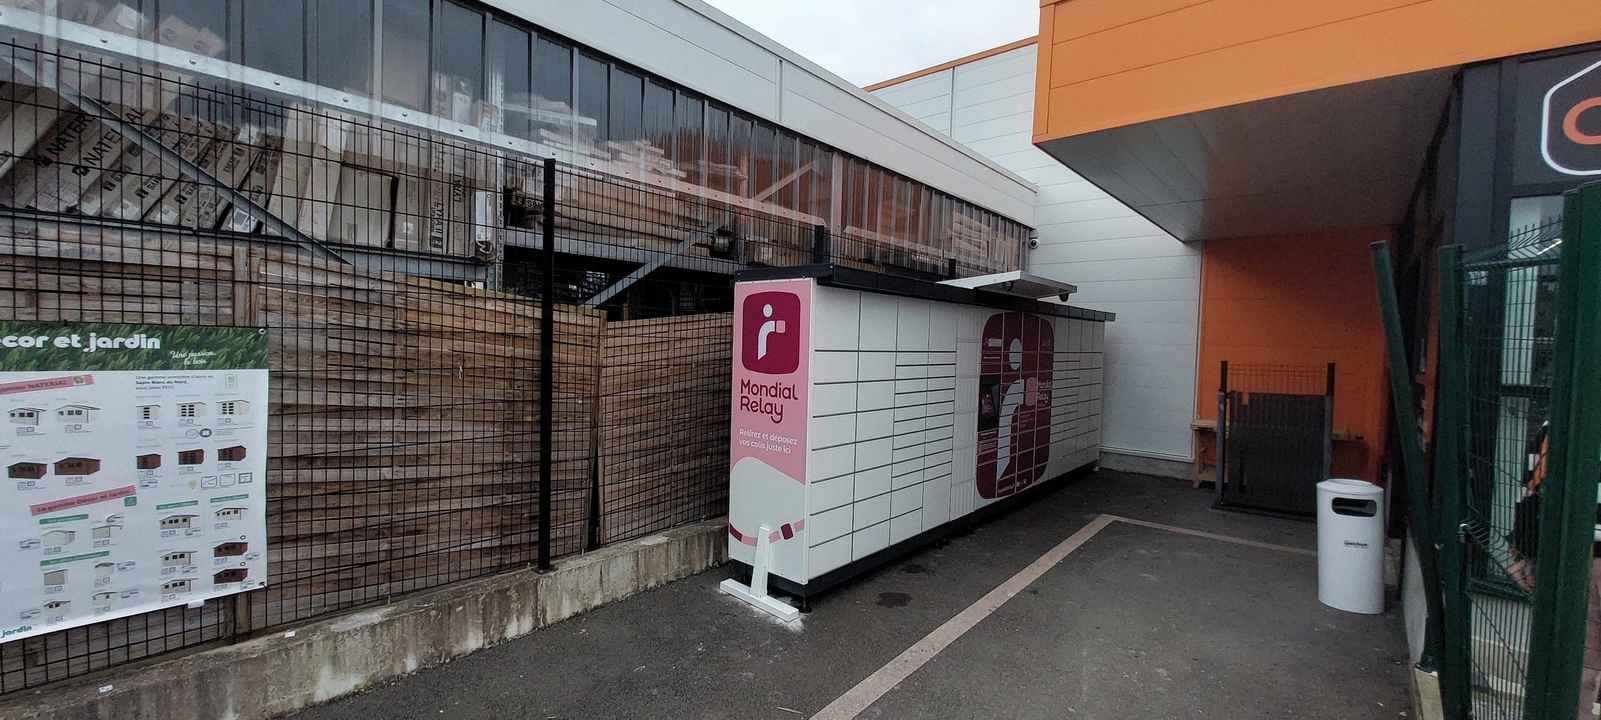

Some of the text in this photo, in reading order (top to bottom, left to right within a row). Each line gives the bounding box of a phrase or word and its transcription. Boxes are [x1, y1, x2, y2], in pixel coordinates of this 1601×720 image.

[82, 108, 149, 166] NATEAL
[0, 332, 160, 352] cor et jardin
[740, 378, 799, 401] Mondial
[740, 395, 784, 424] Relay
[739, 428, 761, 439] Retirez
[769, 433, 798, 446] déposez
[739, 439, 791, 455] vos colis juste ici
[0, 625, 32, 638] jardin
